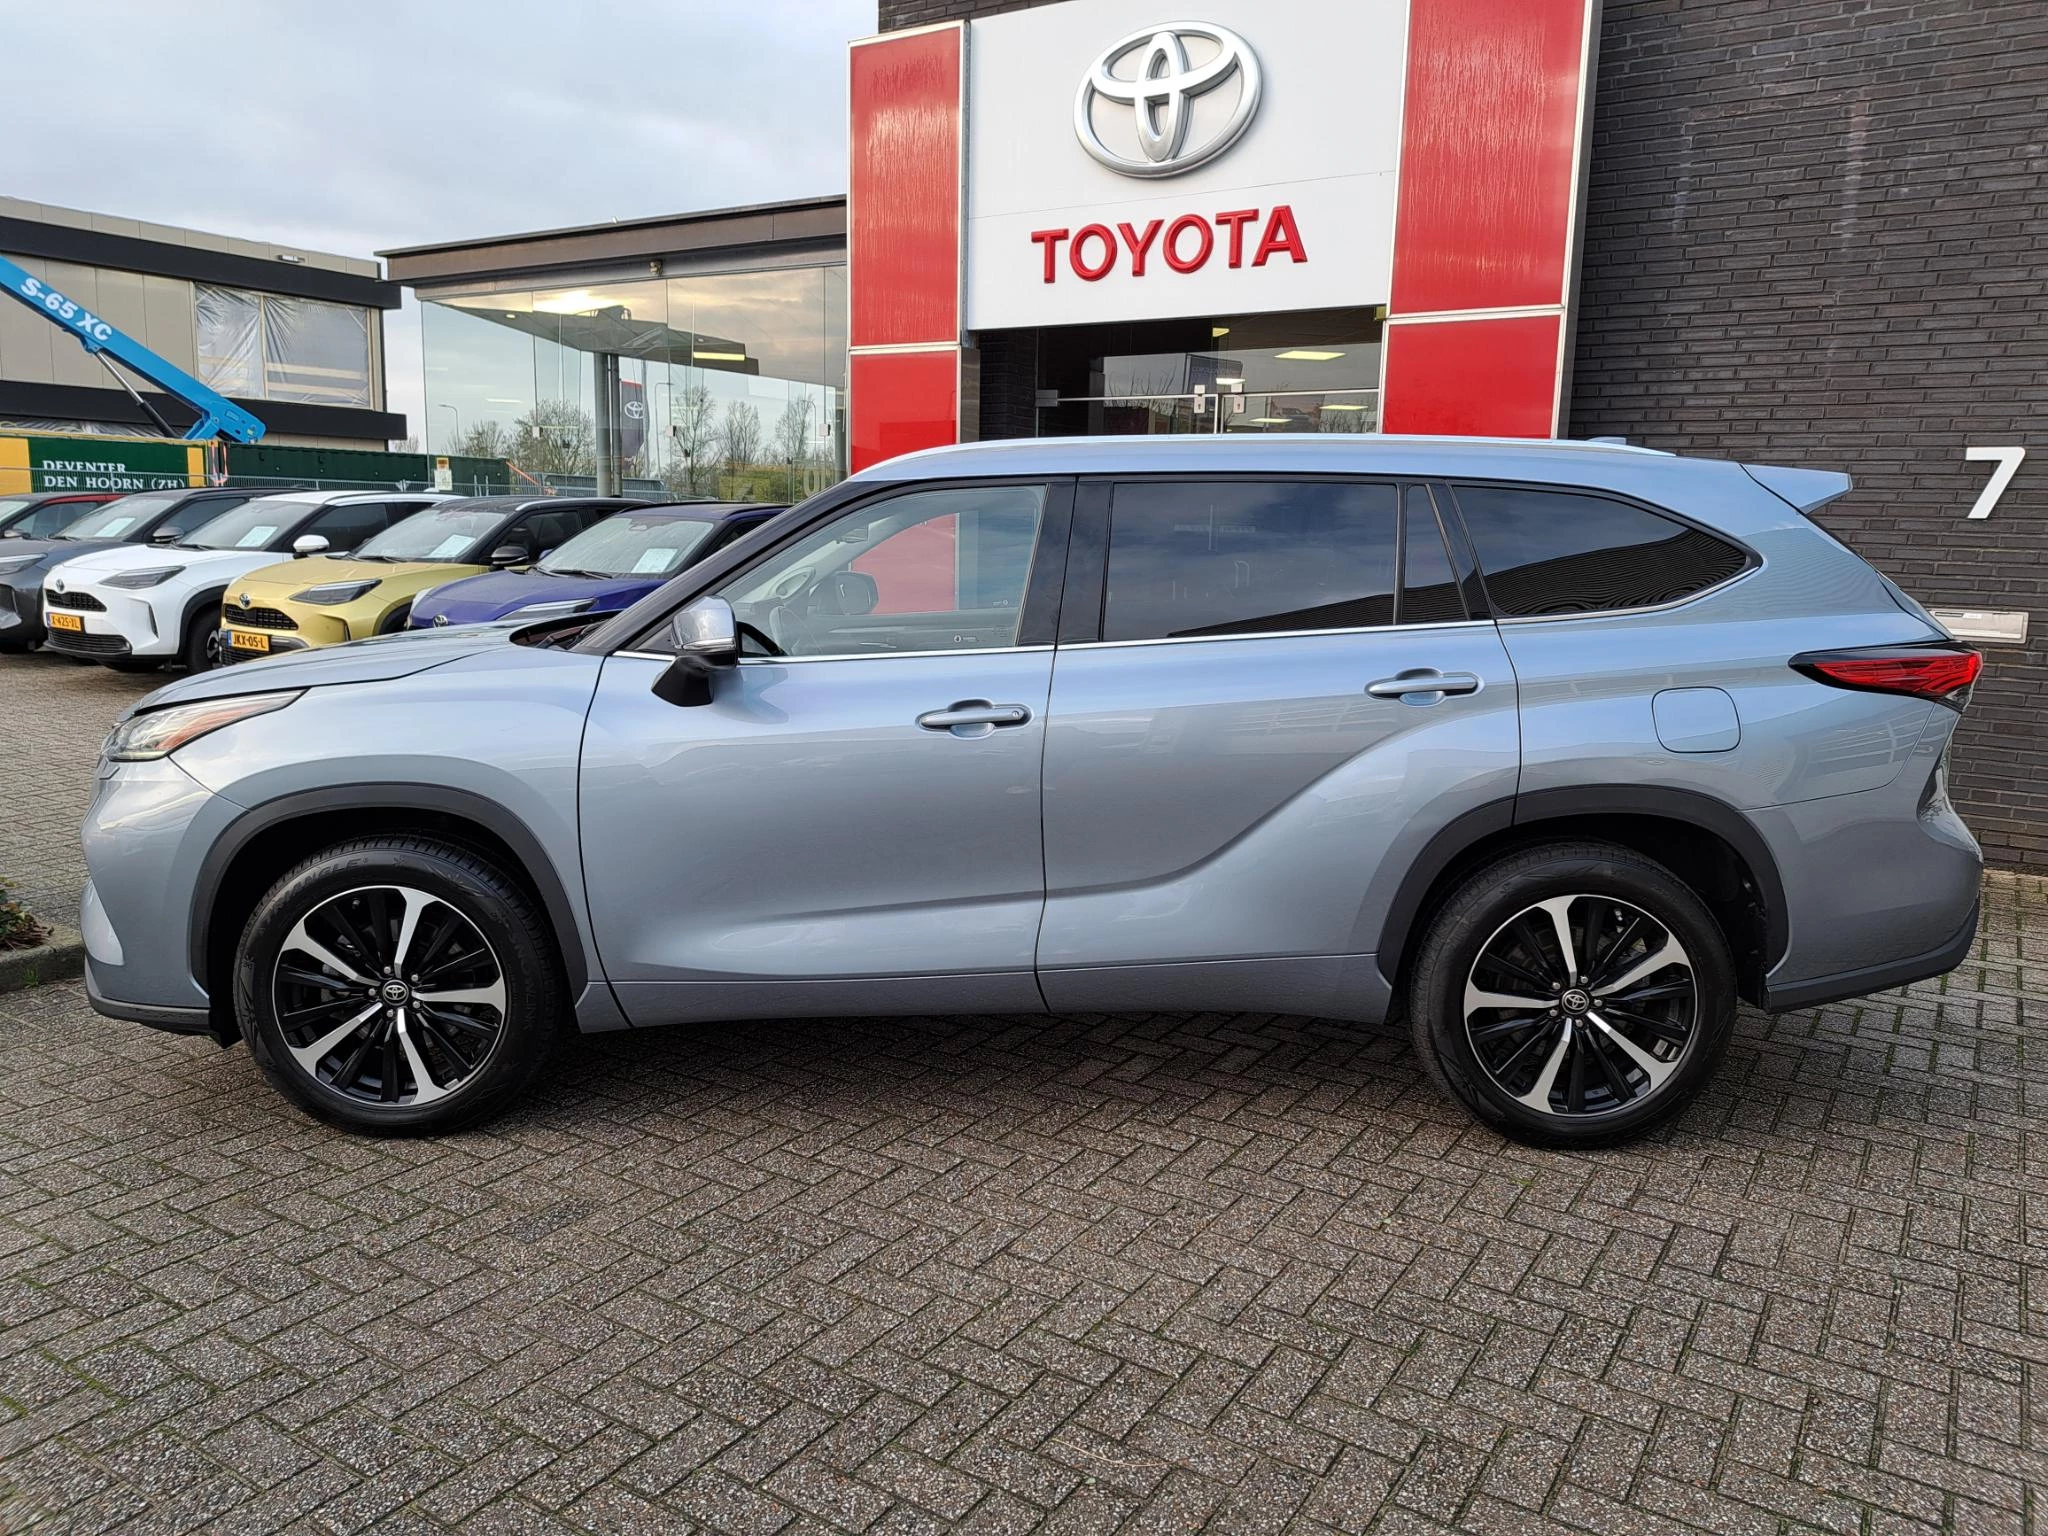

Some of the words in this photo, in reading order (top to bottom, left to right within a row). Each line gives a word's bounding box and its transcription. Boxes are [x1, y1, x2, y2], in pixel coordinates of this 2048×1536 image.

[1031, 205, 1308, 283] TOYOTA
[20, 277, 79, 319] S-65
[76, 312, 113, 341] XC
[42, 460, 126, 473] DEVENTER
[43, 475, 78, 488] DEN
[86, 476, 144, 490] HOORN
[151, 478, 185, 489] (ZH)
[1965, 446, 2026, 519] 7
[233, 633, 266, 649] JKX-05-L
